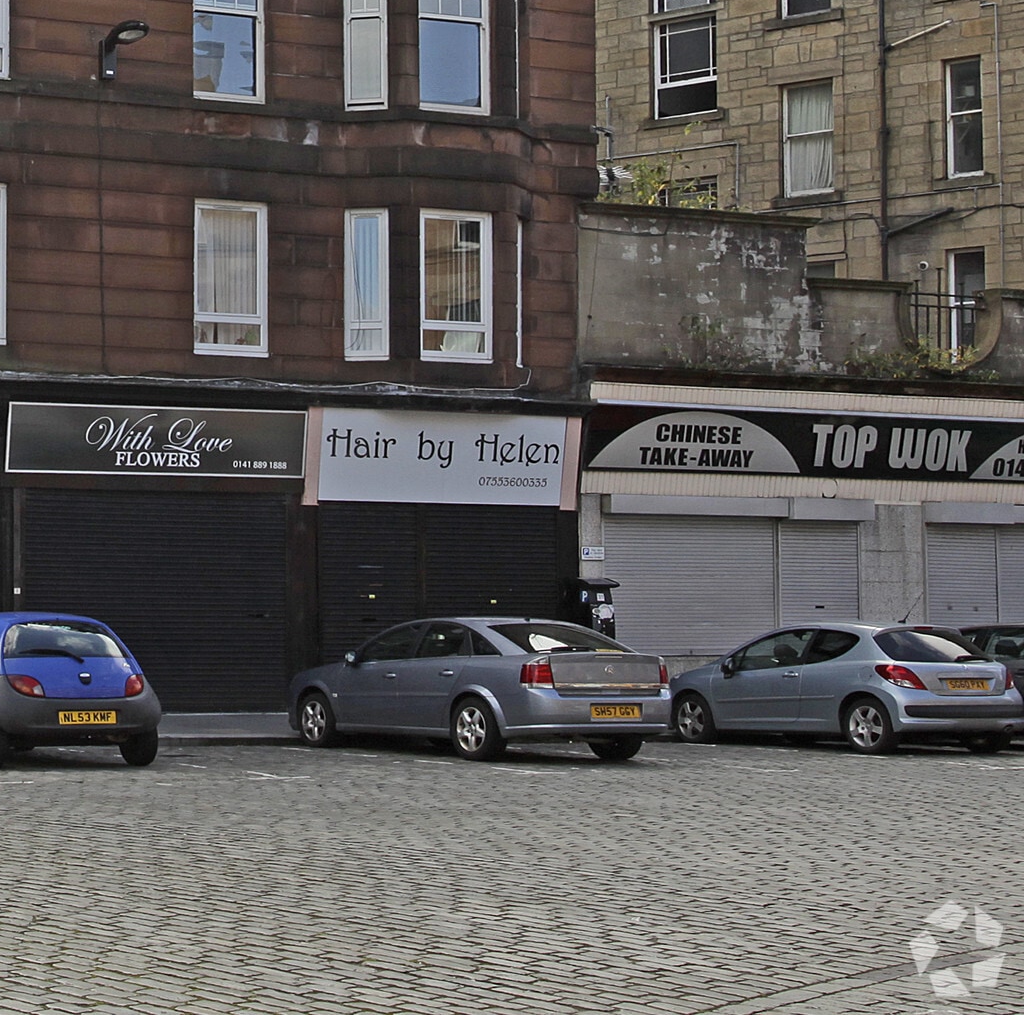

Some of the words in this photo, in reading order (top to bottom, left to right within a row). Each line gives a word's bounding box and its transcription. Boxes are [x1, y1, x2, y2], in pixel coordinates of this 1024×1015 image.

[85, 413, 158, 452] With
[162, 417, 234, 453] Love
[656, 423, 742, 444] CHINESE
[326, 428, 397, 459] Hair
[417, 430, 455, 468] by
[474, 433, 561, 467] Helen
[639, 446, 754, 468] TAKE-AWAY
[812, 423, 878, 468] TOP
[887, 428, 973, 472] WOK
[115, 451, 201, 467] FLOWERS
[232, 460, 252, 469] 0141
[253, 460, 268, 469] 889
[269, 461, 287, 470] 1888
[64, 712, 91, 722] NL53
[93, 712, 112, 722] KMF
[594, 707, 617, 716] SH57
